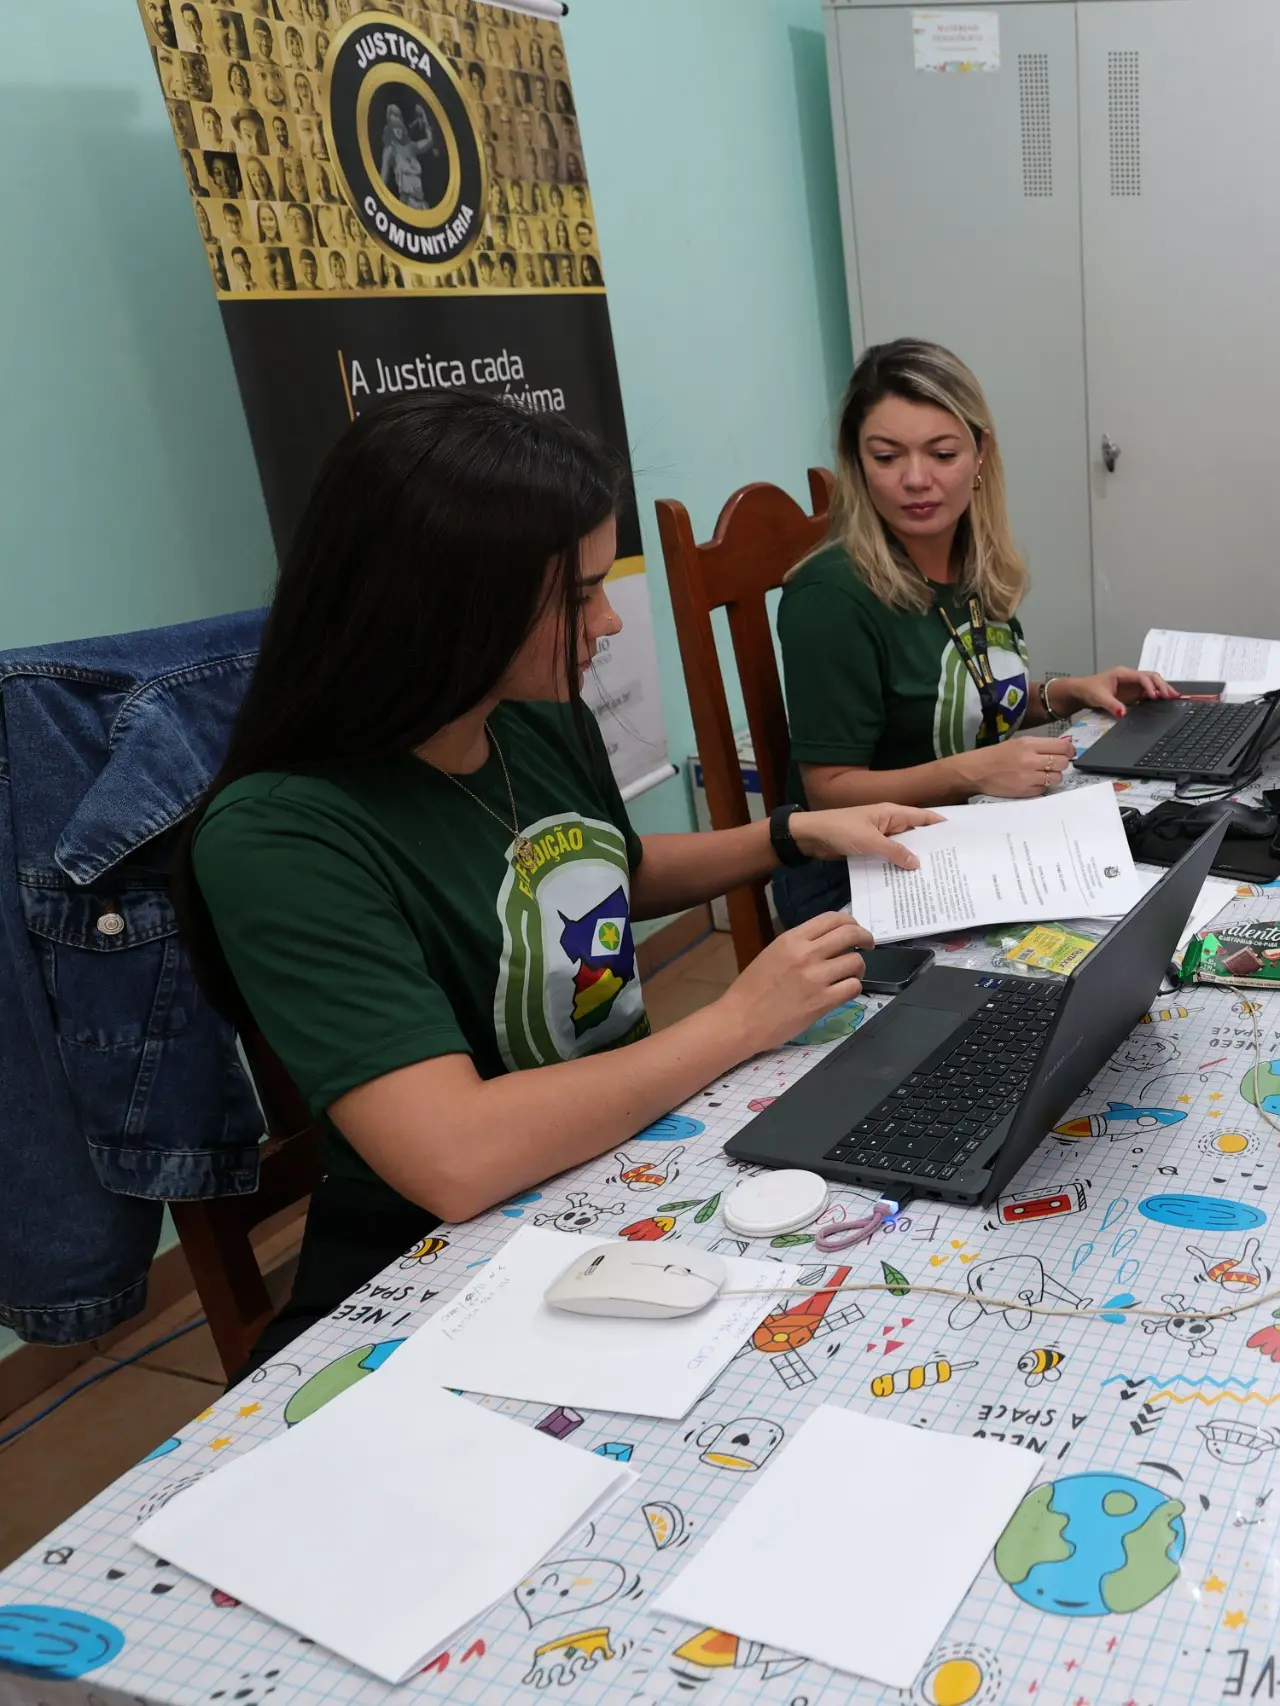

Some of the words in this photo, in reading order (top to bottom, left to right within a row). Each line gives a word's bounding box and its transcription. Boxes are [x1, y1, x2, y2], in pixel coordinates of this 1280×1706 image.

[355, 31, 432, 78] JUSTIÇA
[363, 195, 474, 257] COMUNITÁRIA
[351, 360, 370, 396] A
[471, 349, 524, 384] cada
[1211, 1027, 1263, 1038] SPACE
[1208, 1038, 1261, 1051] NEED
[354, 1282, 414, 1302] SPAC
[420, 1289, 439, 1304] A
[392, 1312, 411, 1328] I
[977, 1403, 1057, 1428] SPACE
[1071, 1412, 1088, 1429] A
[1056, 1440, 1071, 1461] I
